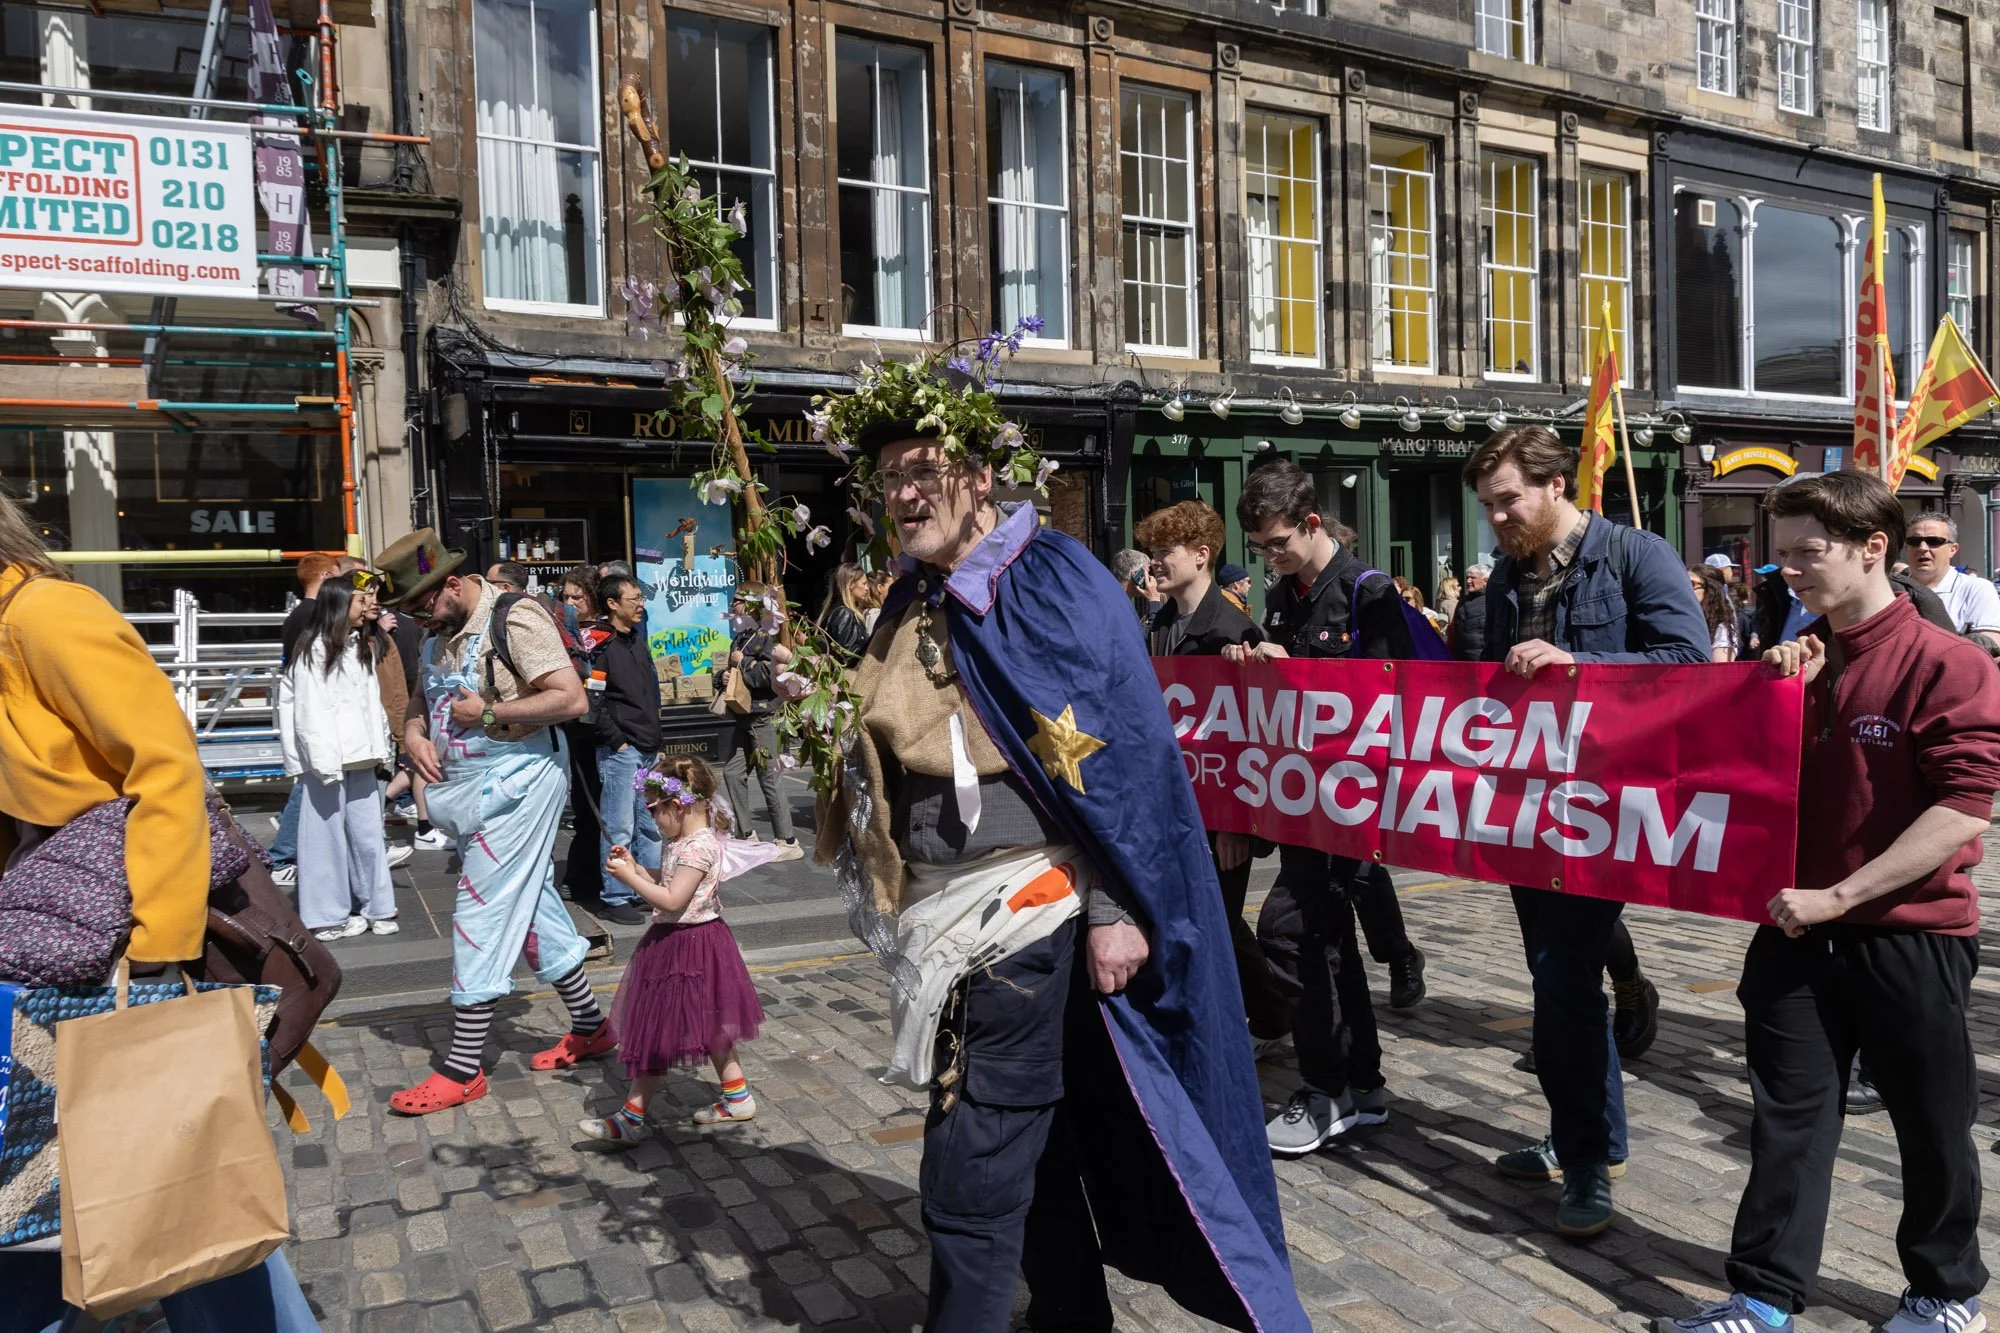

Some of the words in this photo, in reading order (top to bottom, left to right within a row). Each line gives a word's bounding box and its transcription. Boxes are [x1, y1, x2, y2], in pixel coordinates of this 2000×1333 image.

[150, 136, 229, 170] 0131
[162, 179, 225, 211] 210
[152, 219, 239, 252] 0218
[1, 253, 241, 281] spect-scaffolding.com
[1171, 434, 1188, 445] 377
[190, 509, 275, 534] SALE
[655, 568, 735, 592] Worldwide
[669, 591, 719, 608] Shipping
[1163, 683, 1593, 773] CAMPAIGN
[1858, 723, 1888, 738] 1451
[664, 743, 708, 754] HIPPING
[1850, 737, 1893, 747] SCOTLAND
[1181, 750, 1226, 788] OR
[1233, 748, 1730, 873] SOCIALISM
